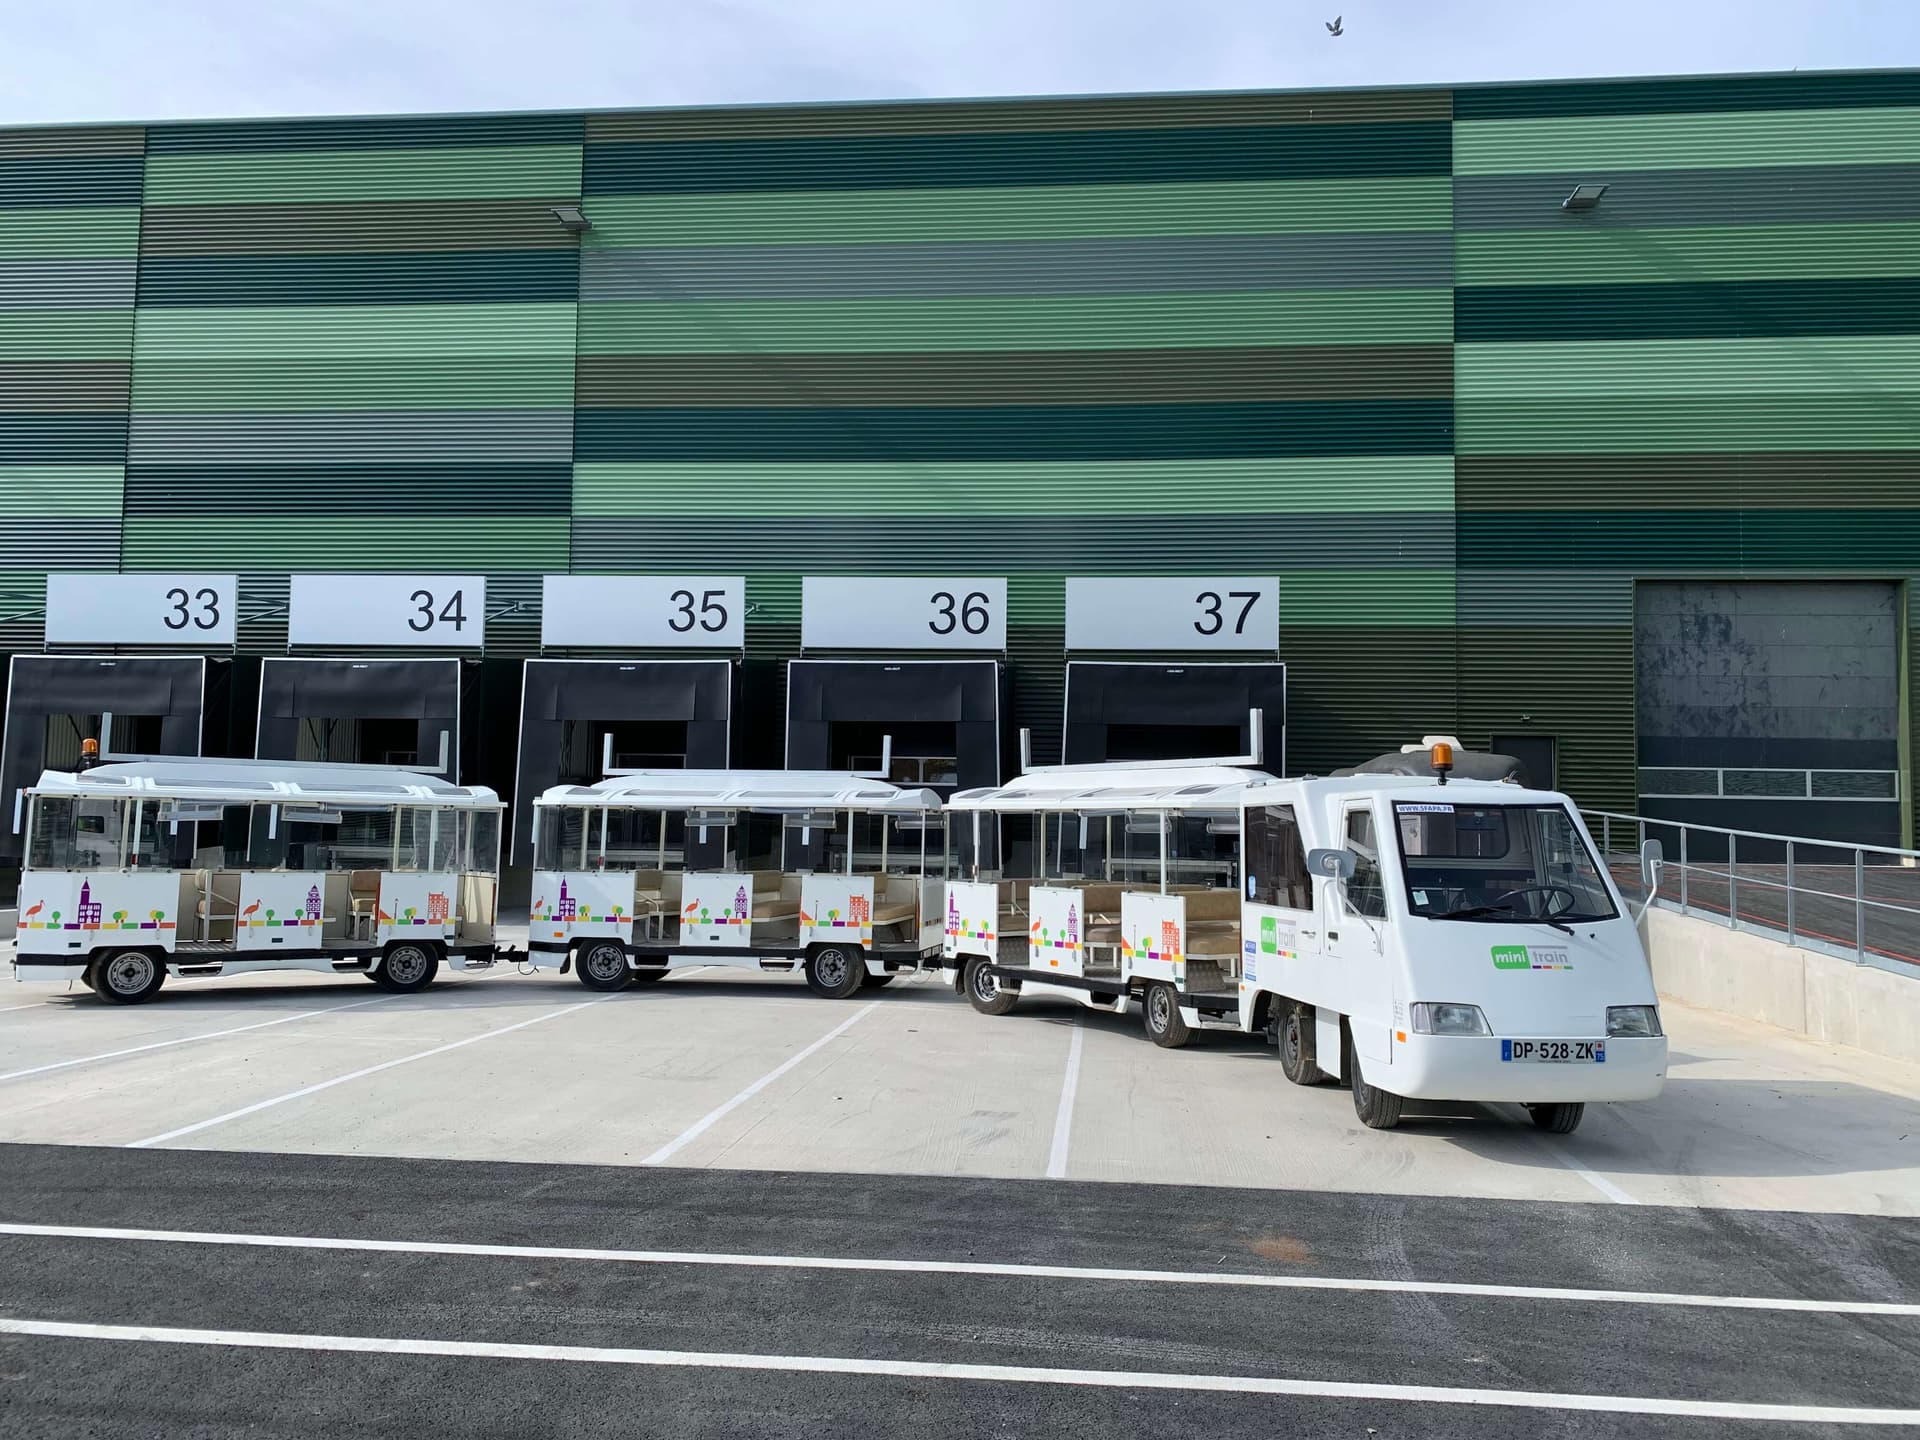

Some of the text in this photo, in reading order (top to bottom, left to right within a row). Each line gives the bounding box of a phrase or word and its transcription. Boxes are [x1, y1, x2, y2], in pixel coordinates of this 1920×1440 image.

[164, 588, 220, 630] 33
[407, 589, 467, 632] 34
[668, 589, 728, 633] 35
[928, 591, 990, 635] 36
[1193, 591, 1261, 636] 37
[1261, 925, 1276, 944] mini
[1278, 927, 1296, 947] train
[1495, 950, 1569, 963] mini train
